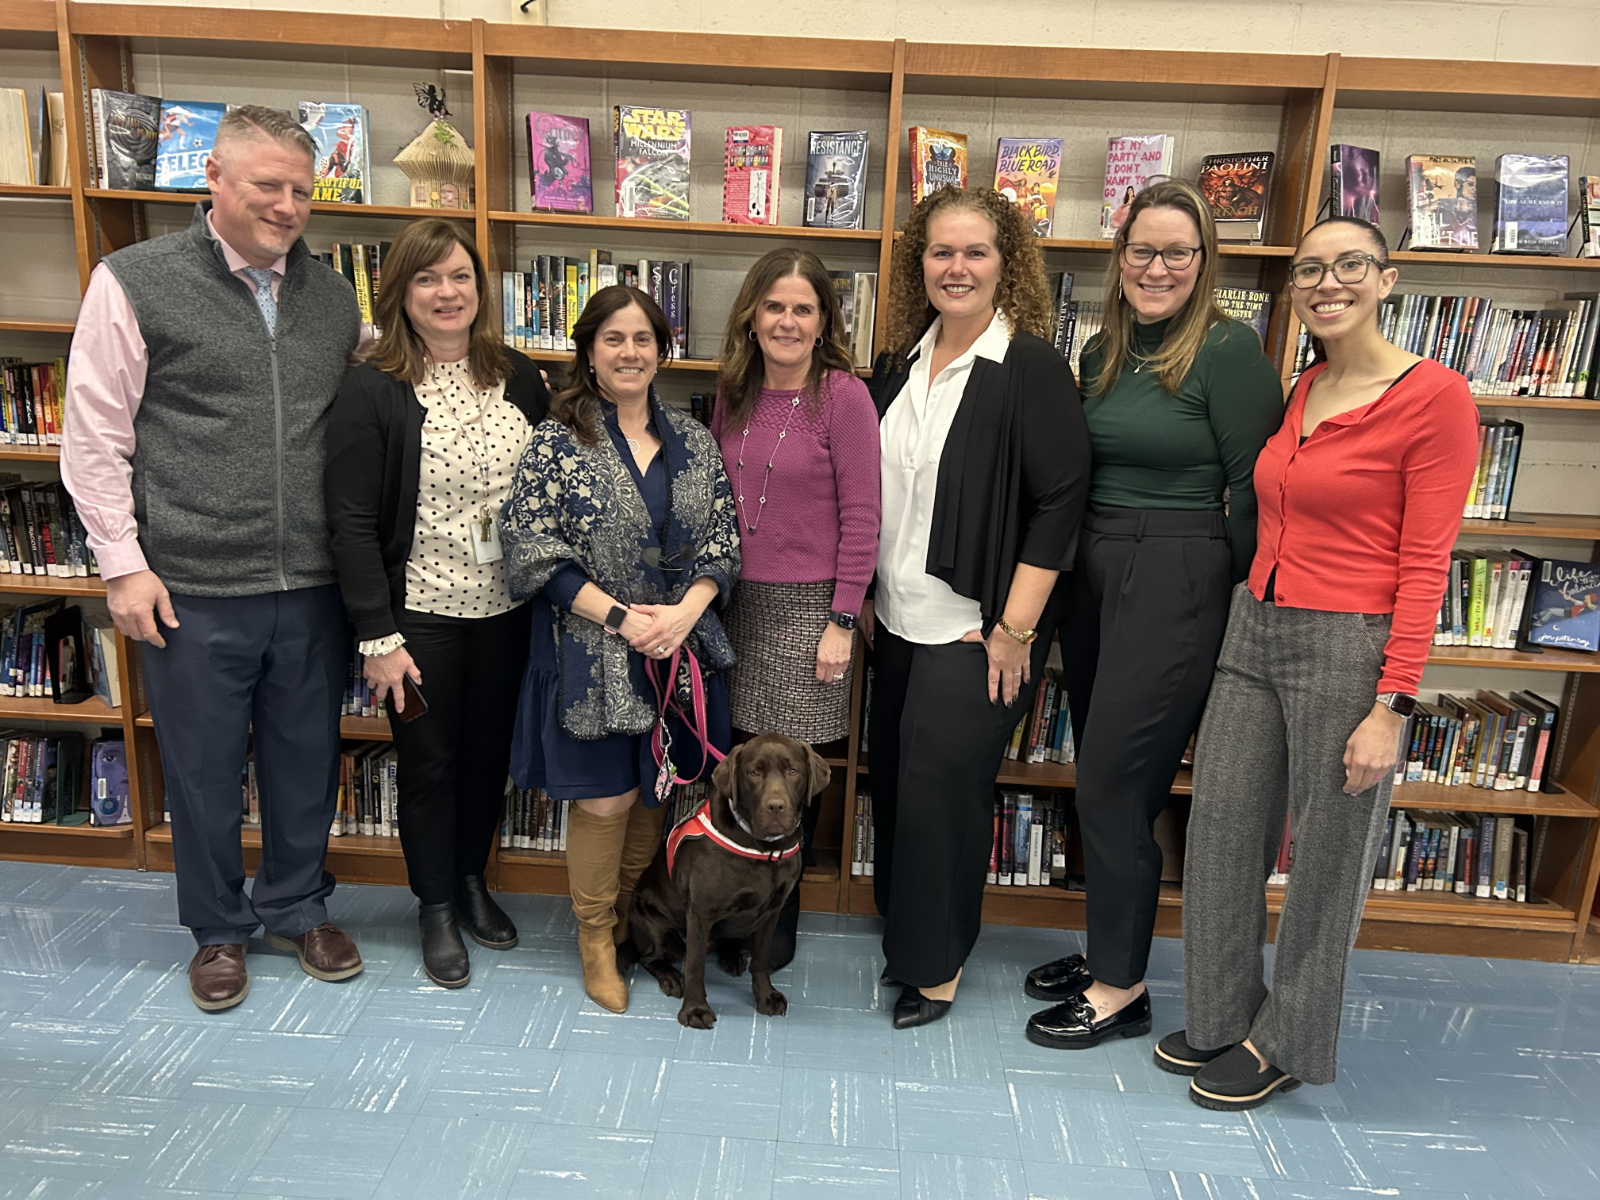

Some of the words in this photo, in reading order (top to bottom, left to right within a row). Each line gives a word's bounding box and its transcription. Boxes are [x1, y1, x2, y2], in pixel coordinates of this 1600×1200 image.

[623, 109, 682, 126] STAR
[623, 122, 685, 141] WARS
[630, 140, 677, 150] MILLENNIUM
[810, 140, 862, 155] RESISTANCE
[1130, 140, 1143, 151] MY
[639, 148, 668, 156] FALCON
[1001, 146, 1032, 158] BLACK
[1108, 152, 1138, 163] PARTY
[1141, 151, 1162, 162] AND
[157, 152, 210, 172] SELEC
[999, 160, 1027, 172] BLUE
[1027, 160, 1057, 172] ROAD
[1202, 156, 1269, 164] CHRISTOPHER
[928, 164, 958, 175] HIGHLY
[1106, 164, 1111, 174] I
[1201, 162, 1268, 174] PAOLINI
[313, 176, 363, 190] EAUTIFUL
[929, 172, 958, 184] UNUSUAL
[1106, 176, 1131, 186] WANT
[1135, 176, 1146, 185] TO
[311, 187, 342, 202] AME
[1104, 188, 1116, 198] GO
[1213, 206, 1259, 217] RTAGH
[1460, 231, 1478, 247] LIE
[668, 268, 678, 318] Cress
[1213, 288, 1246, 300] CHARLIE
[1248, 292, 1270, 302] BONE
[1231, 300, 1244, 308] THE
[1246, 302, 1262, 310] TIME
[540, 299, 550, 328] UNWAN
[1224, 308, 1252, 318] TWISTER
[1550, 566, 1592, 586] life
